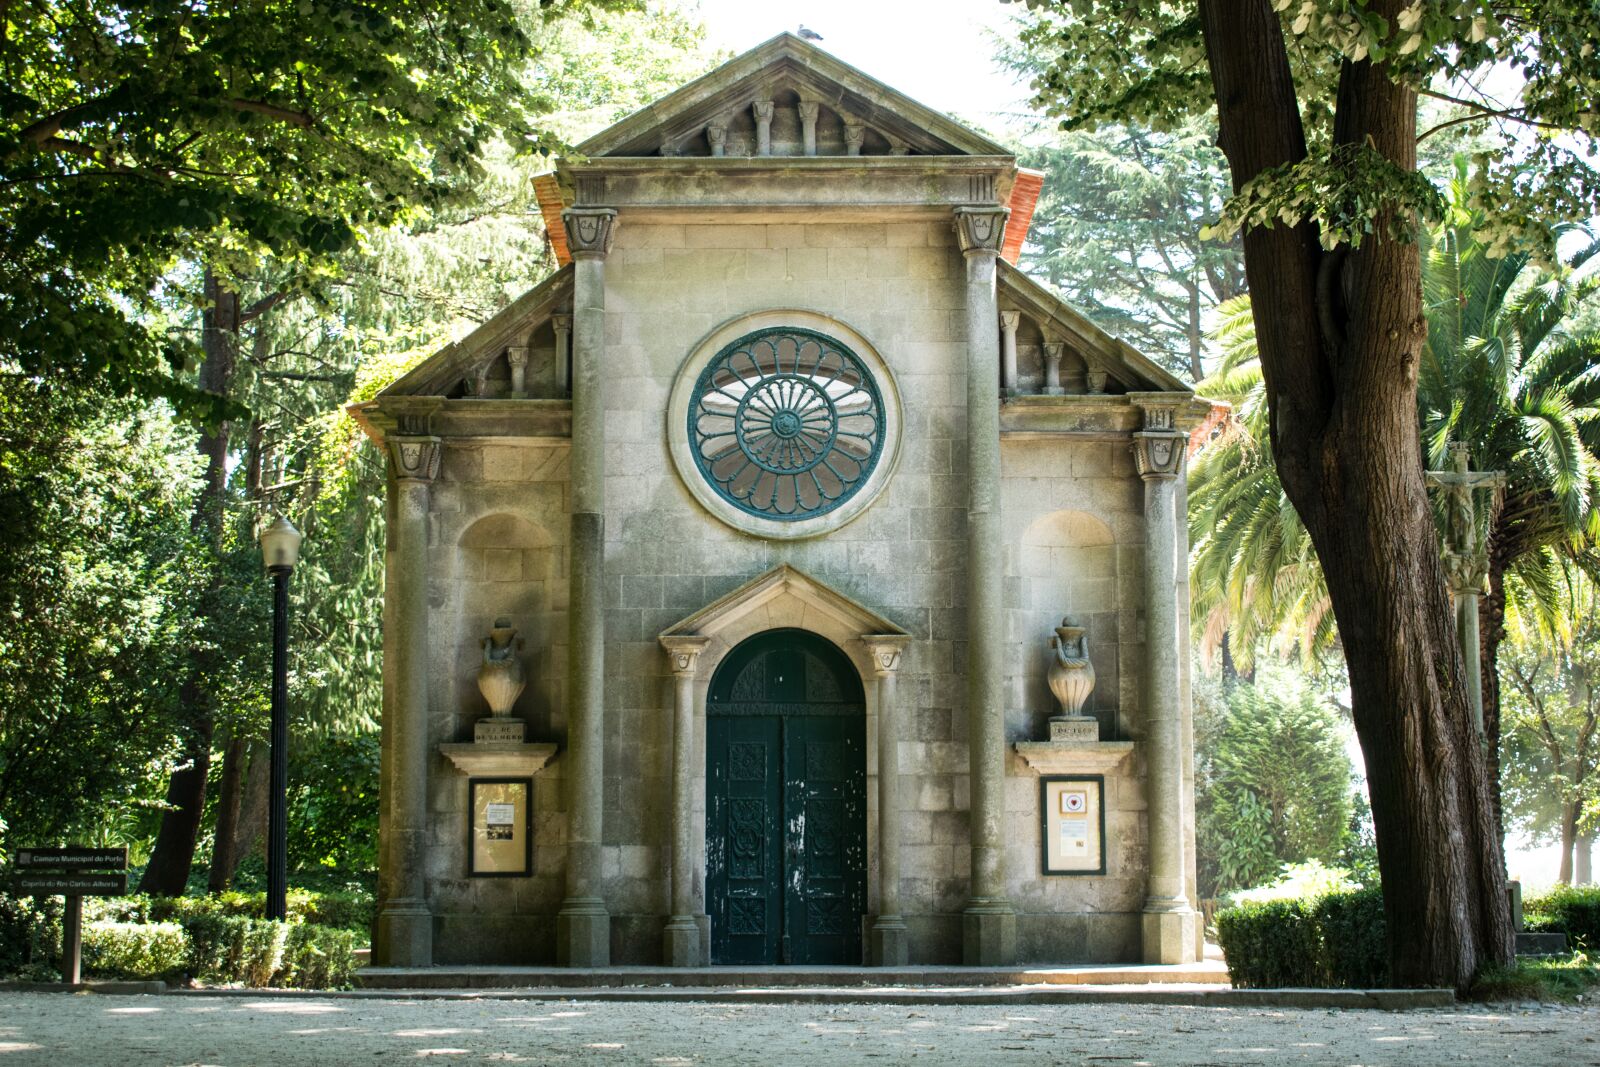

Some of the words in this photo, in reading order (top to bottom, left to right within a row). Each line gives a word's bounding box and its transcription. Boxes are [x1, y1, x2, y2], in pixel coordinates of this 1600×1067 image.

[61, 855, 94, 864] Municipal
[104, 855, 124, 863] Porto
[69, 879, 92, 887] Carlos
